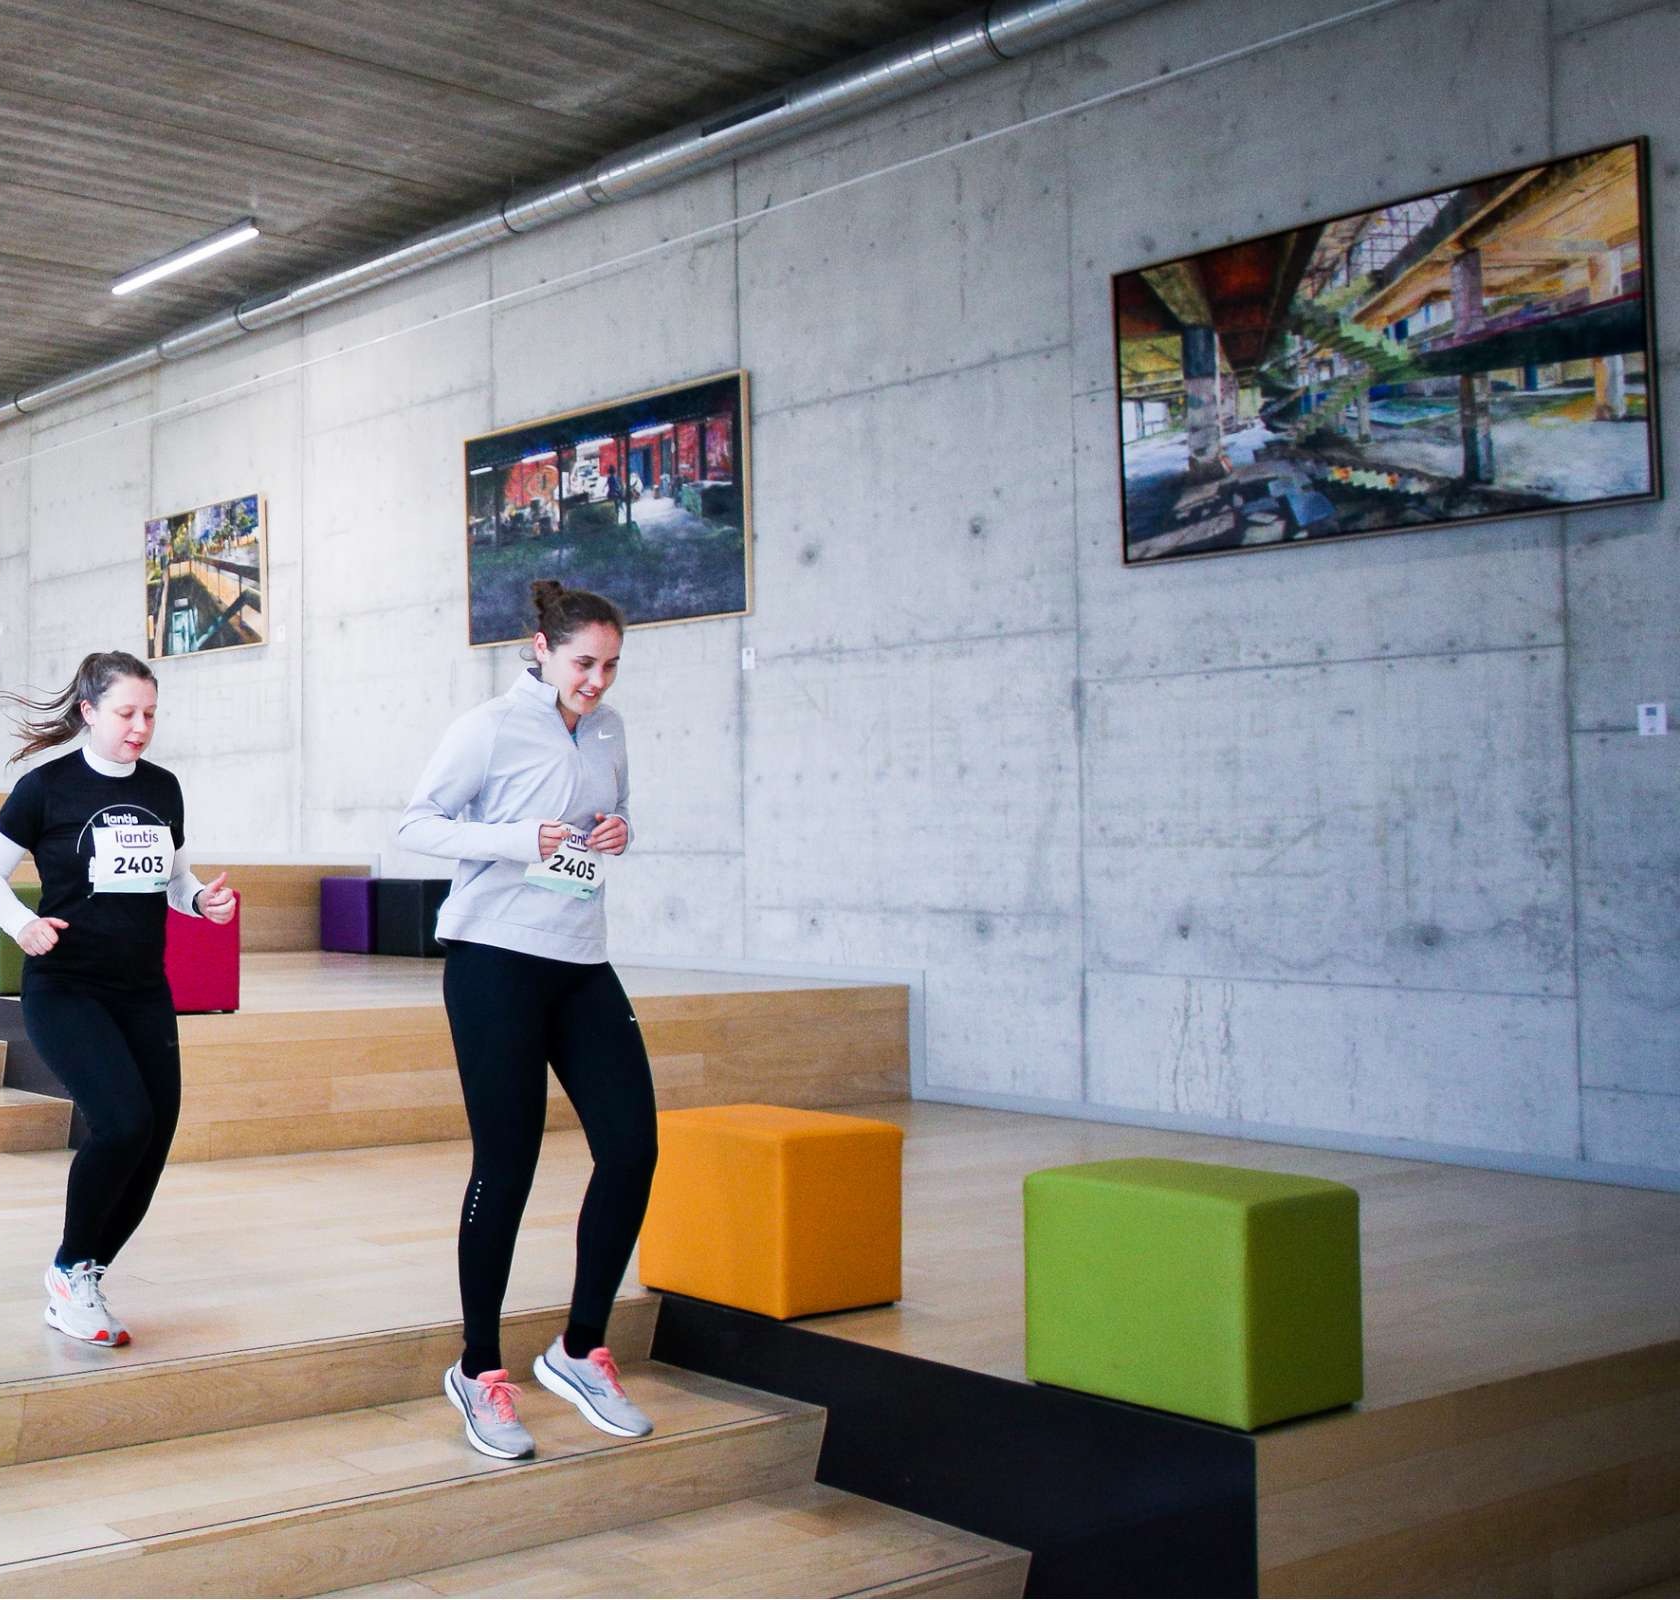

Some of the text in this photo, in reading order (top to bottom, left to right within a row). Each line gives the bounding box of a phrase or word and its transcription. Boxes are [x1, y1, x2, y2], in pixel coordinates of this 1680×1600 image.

[102, 812, 139, 826] liantis
[115, 829, 159, 847] liantis
[113, 855, 164, 874] 2403
[548, 854, 596, 881] 2405
